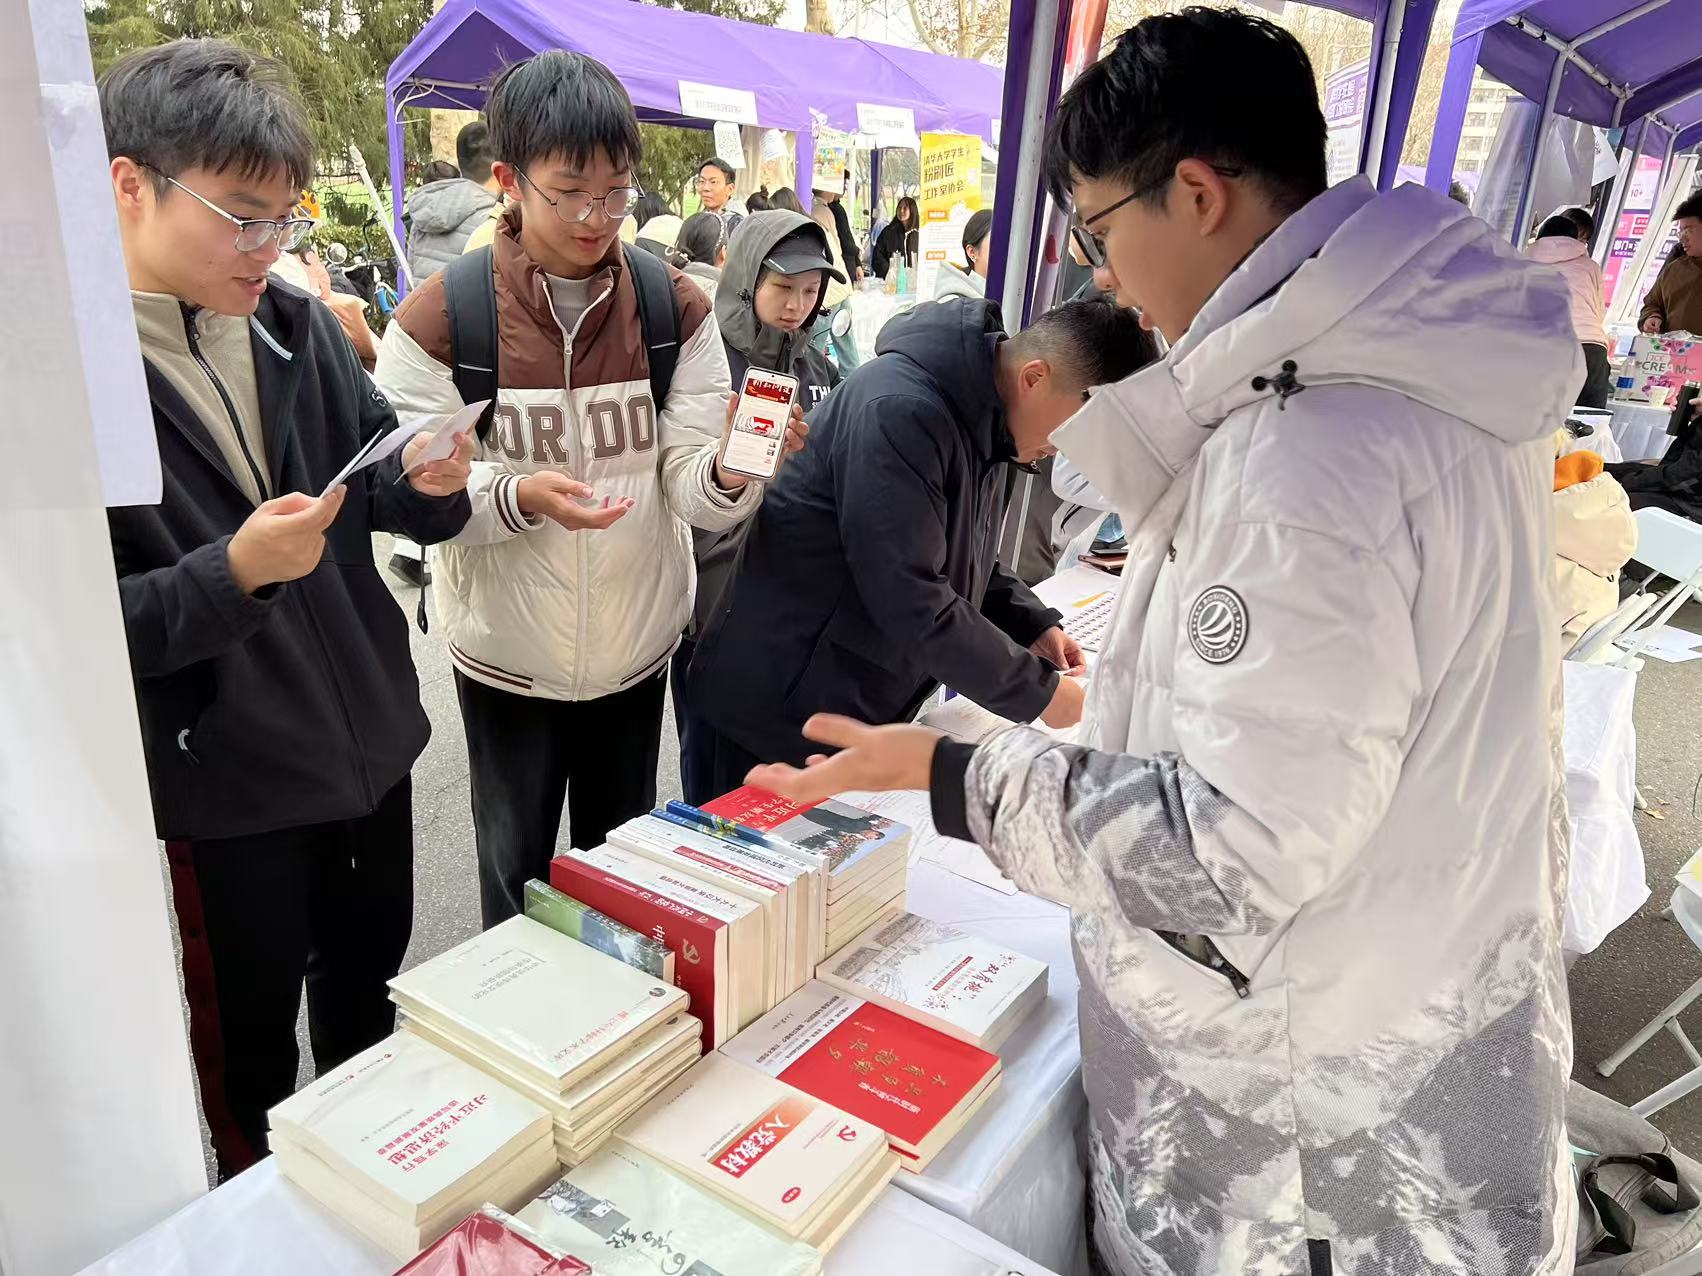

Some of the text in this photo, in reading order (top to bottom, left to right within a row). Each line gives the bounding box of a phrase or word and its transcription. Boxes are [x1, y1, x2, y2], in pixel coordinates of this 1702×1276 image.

[924, 180, 965, 201] 工作室协会
[857, 1081, 922, 1115] 新时代奋斗者
[387, 1093, 489, 1166] 习近平经济思想
[719, 1112, 791, 1174] 入党教材
